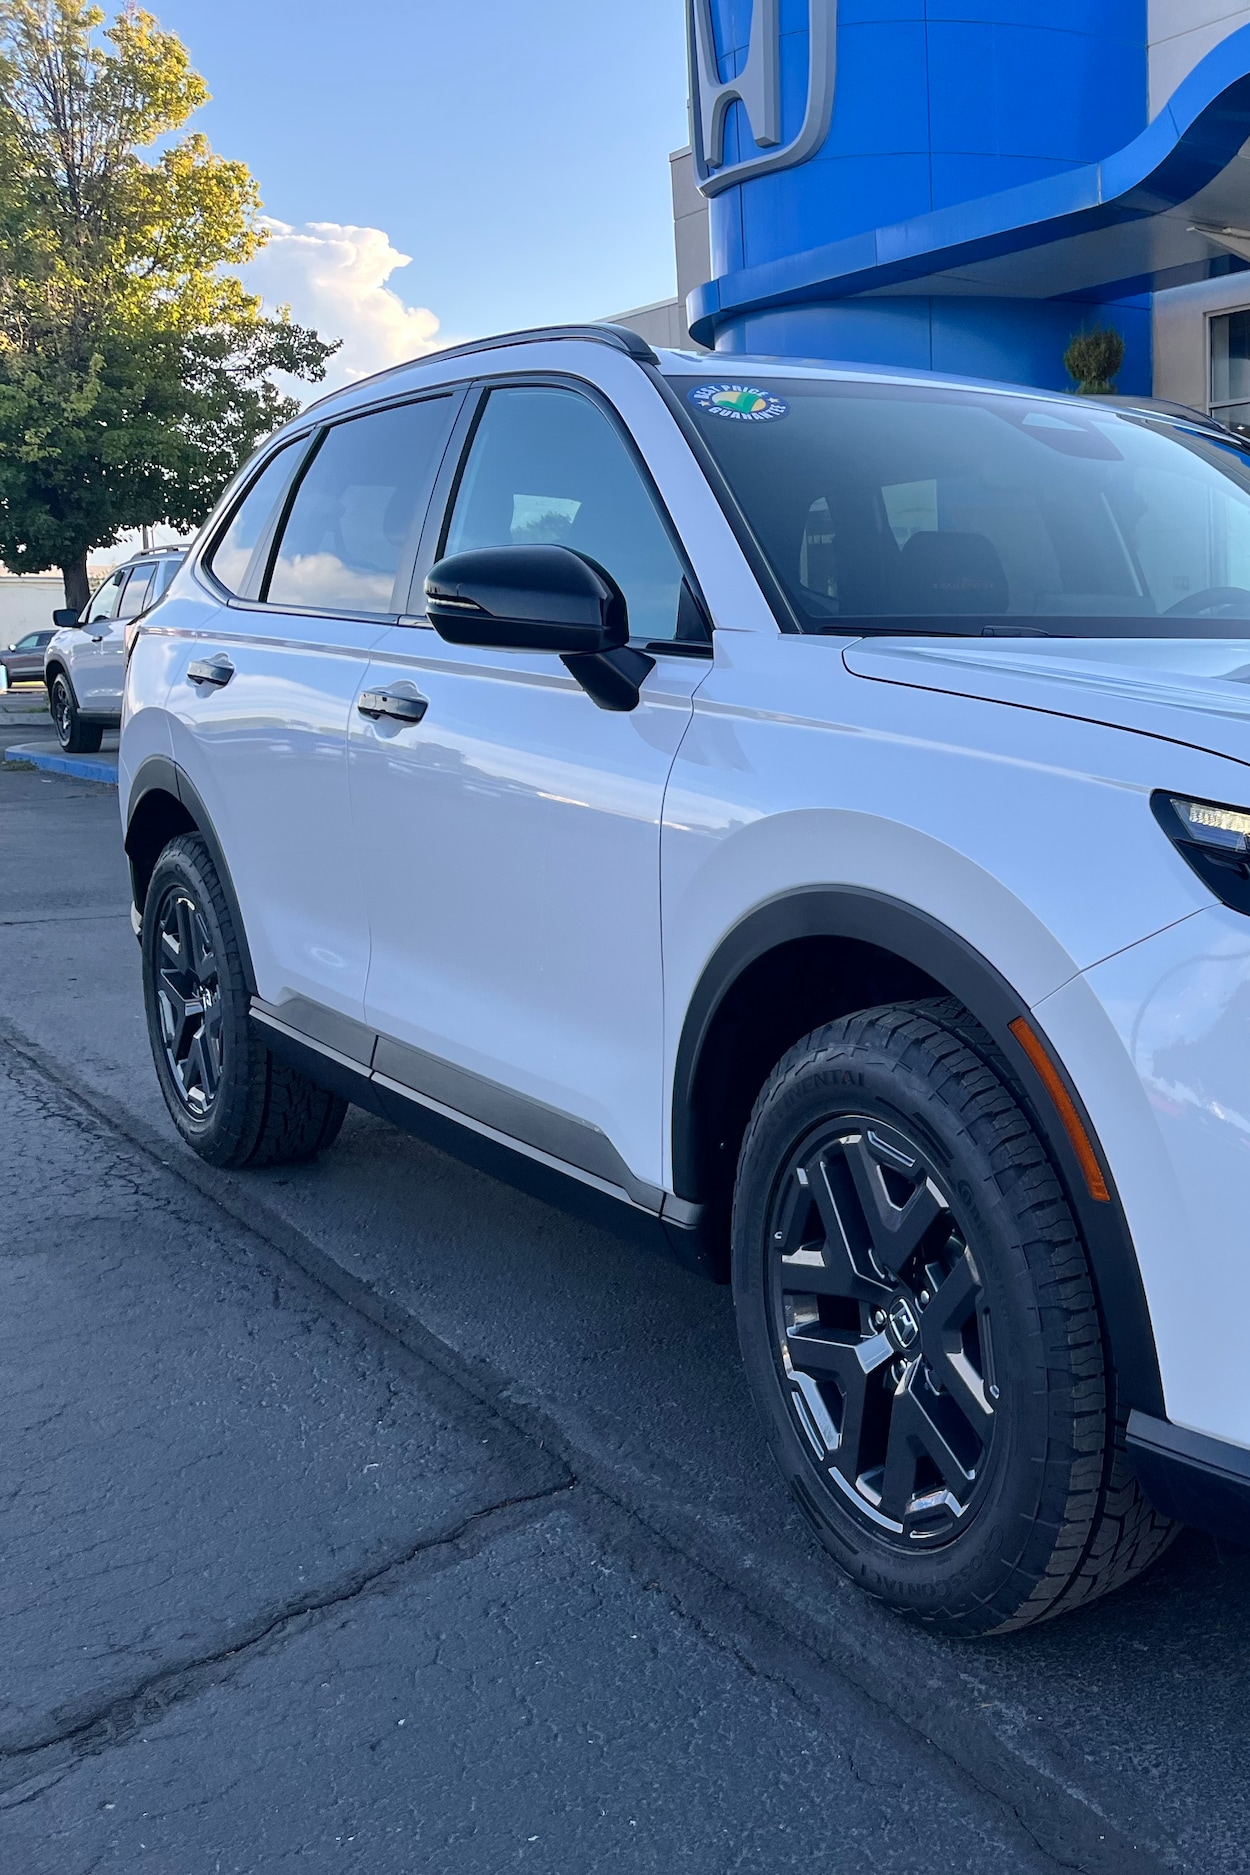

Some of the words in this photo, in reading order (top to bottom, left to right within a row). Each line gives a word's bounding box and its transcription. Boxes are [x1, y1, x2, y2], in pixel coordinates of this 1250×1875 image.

[694, 385, 721, 400] BEST
[720, 384, 769, 398] PRICE
[709, 404, 786, 420] GUARANTEE
